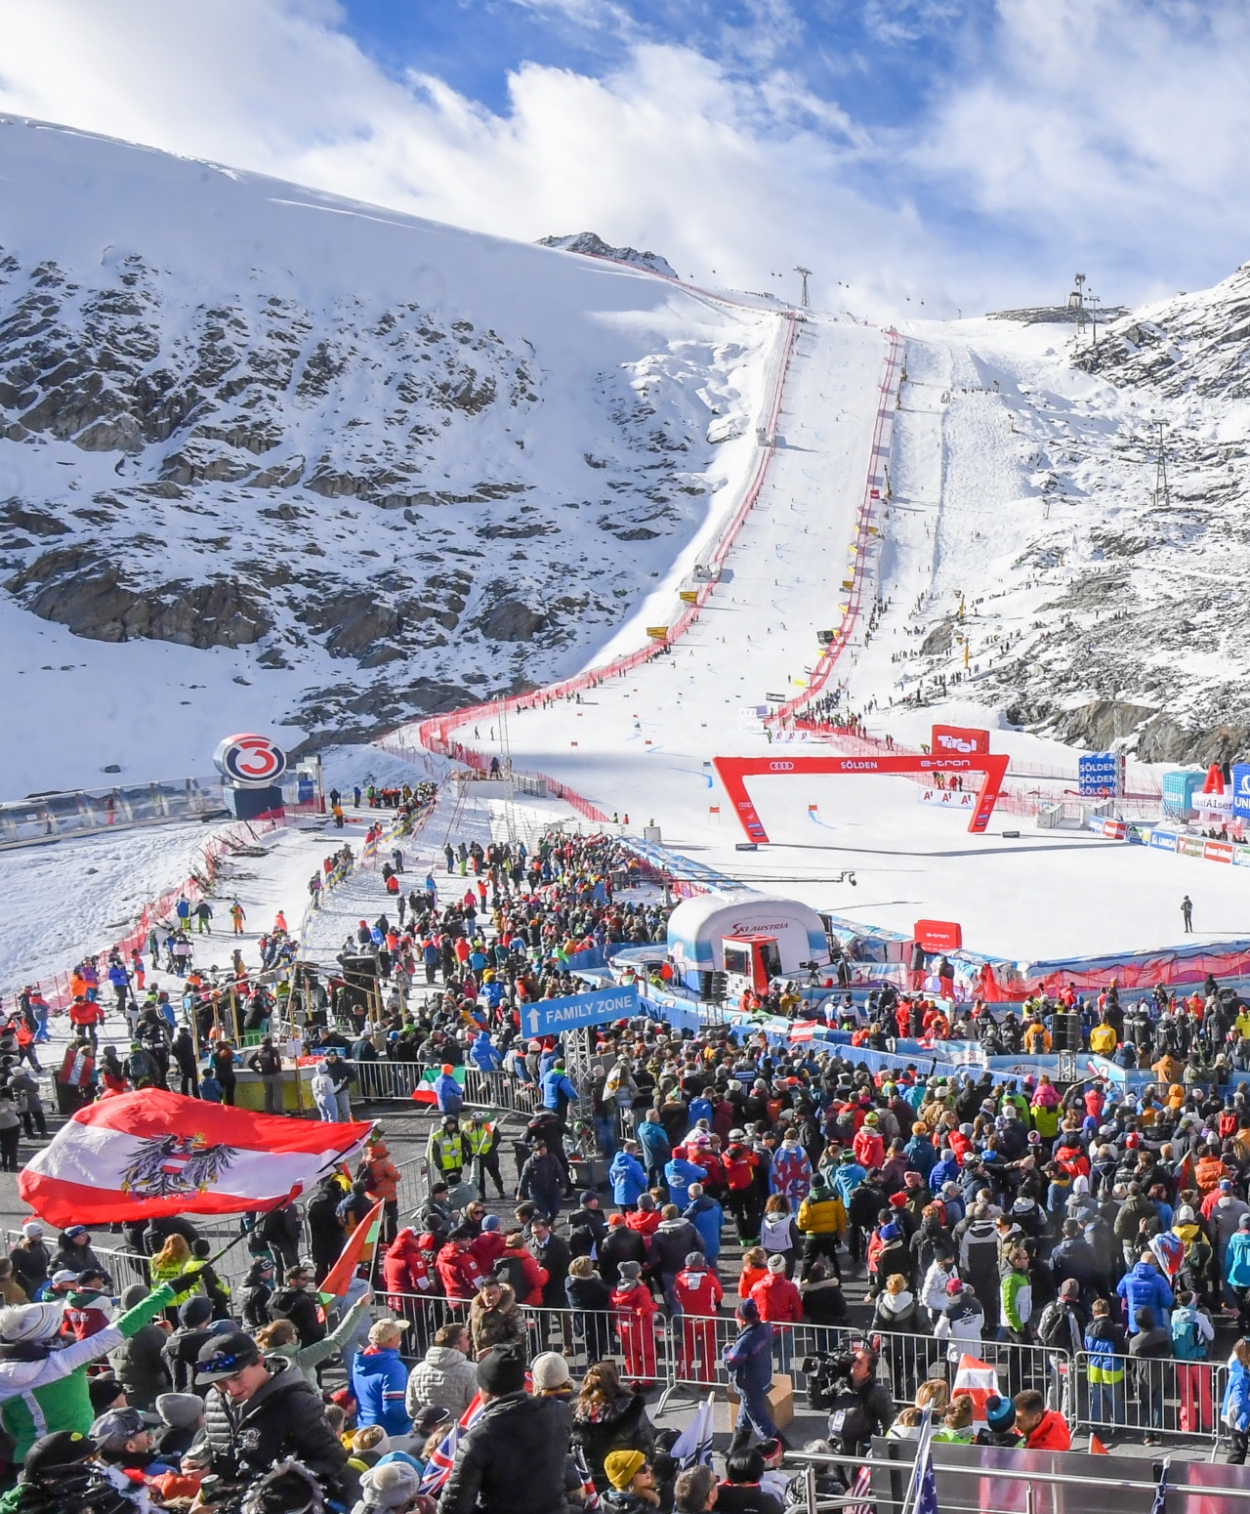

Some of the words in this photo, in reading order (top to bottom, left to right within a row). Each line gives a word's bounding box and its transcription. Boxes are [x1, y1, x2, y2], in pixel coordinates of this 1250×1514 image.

[841, 760, 878, 769] SÖLDEN
[1080, 762, 1117, 772] SÖLDEN
[1080, 774, 1117, 784] SÖLDEN
[750, 922, 789, 932] AUSTRIA
[545, 1003, 594, 1024] FAMILY
[597, 995, 633, 1014] ZONE
